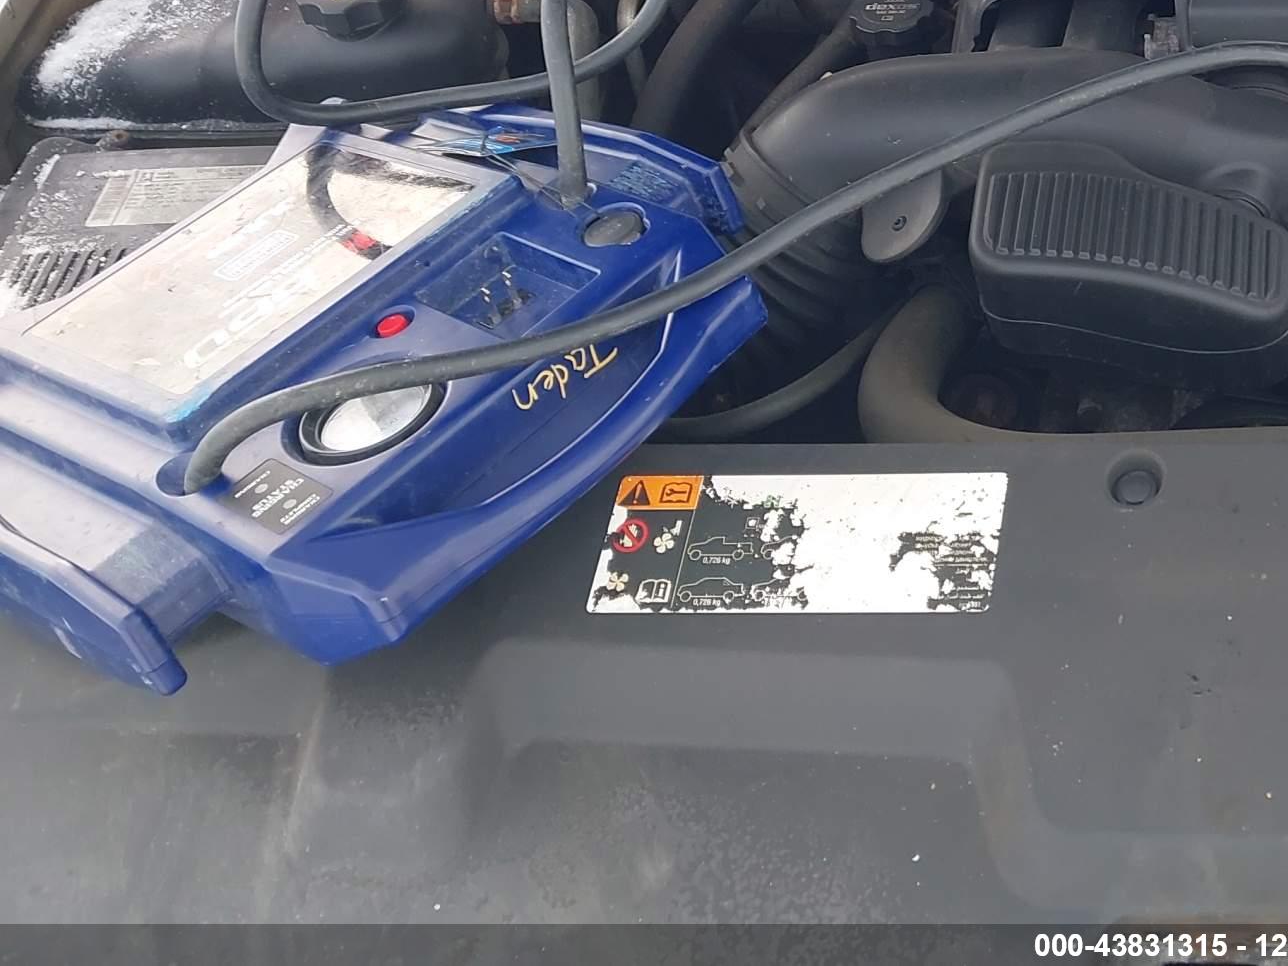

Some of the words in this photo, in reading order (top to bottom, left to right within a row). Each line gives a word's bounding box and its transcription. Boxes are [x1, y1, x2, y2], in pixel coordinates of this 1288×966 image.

[865, 2, 920, 10] dexos
[511, 343, 618, 410] Taden
[251, 479, 294, 511] STATUS
[251, 478, 304, 518] CHARGING
